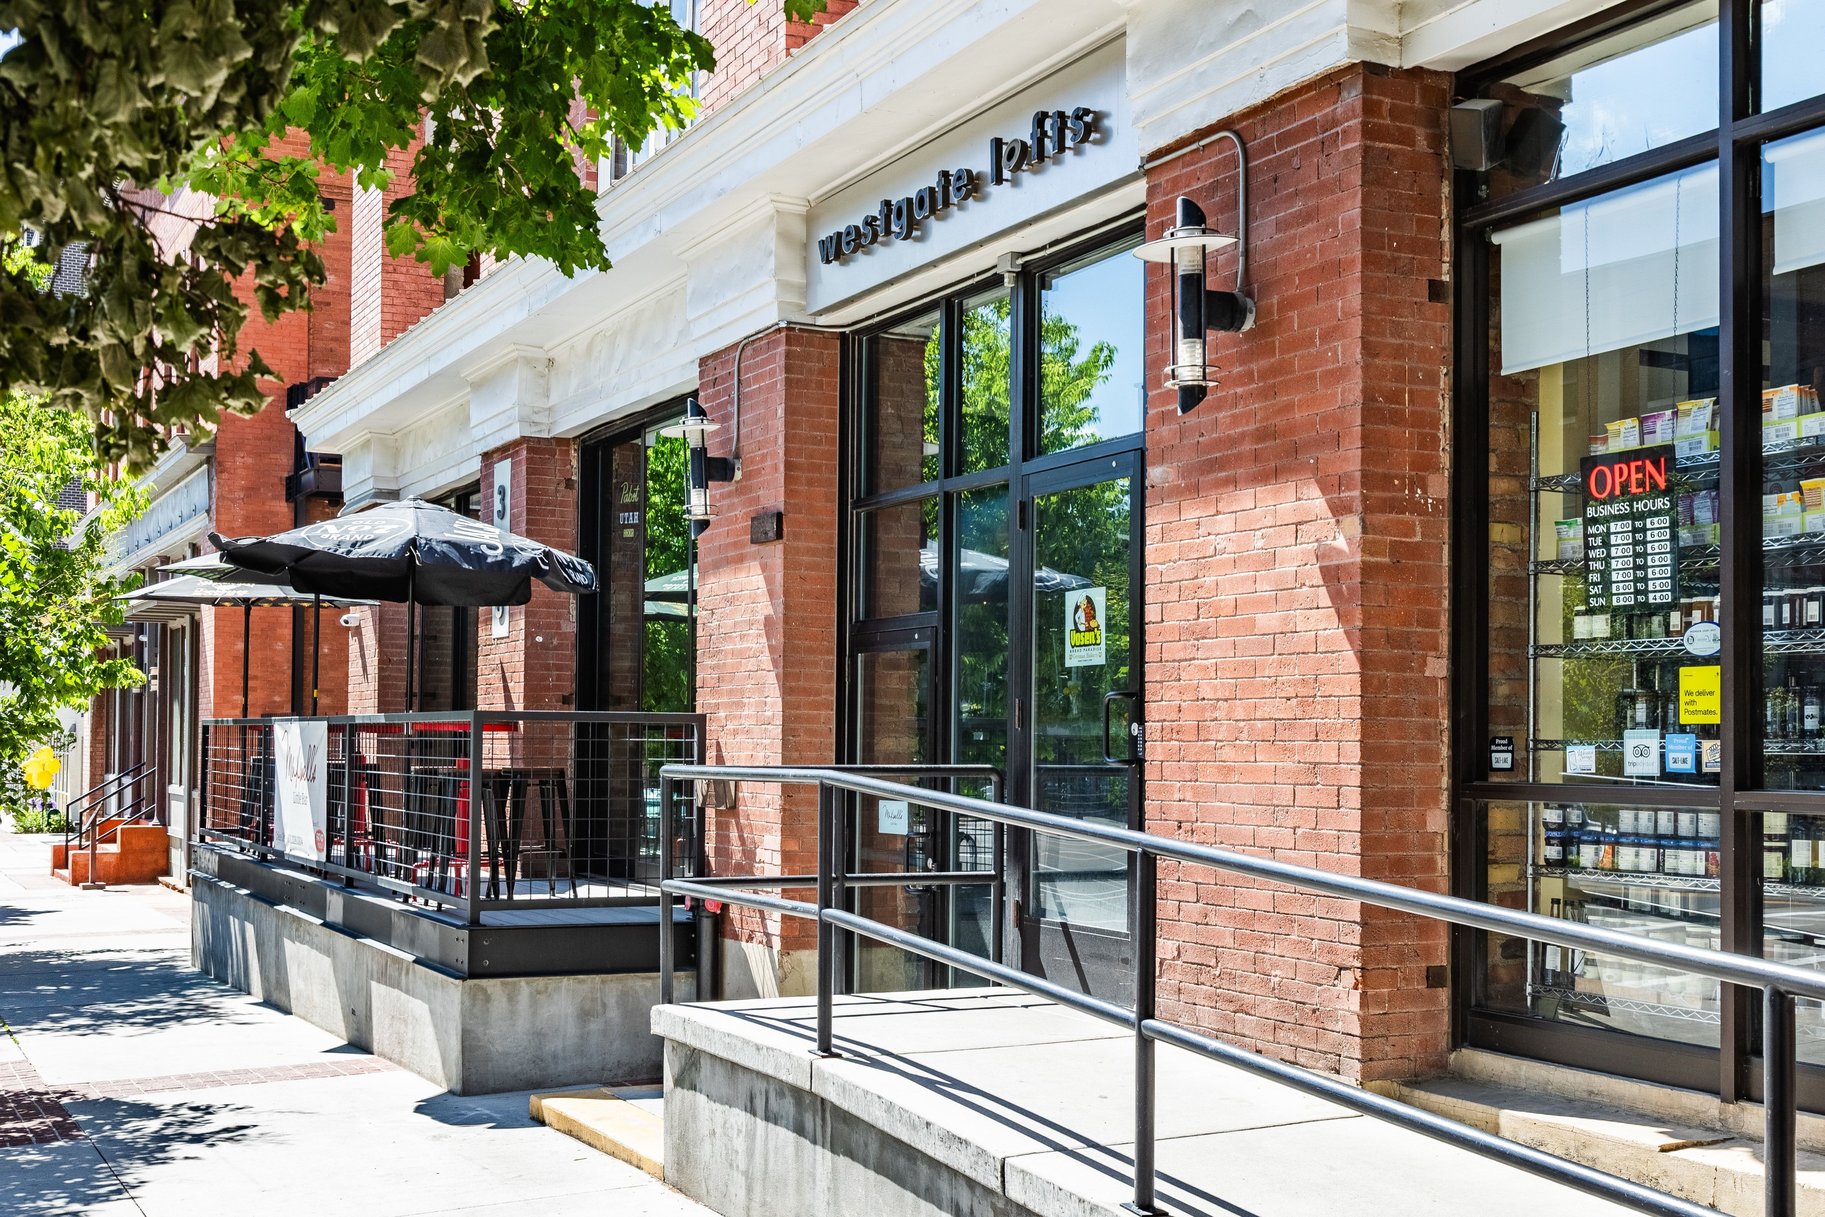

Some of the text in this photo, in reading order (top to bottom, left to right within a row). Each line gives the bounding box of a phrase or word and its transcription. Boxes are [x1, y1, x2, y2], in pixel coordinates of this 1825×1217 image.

[818, 106, 1092, 264] westgate lofts
[1589, 457, 1667, 499] OPEN
[620, 482, 640, 503] Pabst
[1587, 497, 1670, 517] BUSINESS HOURS
[619, 512, 639, 524] UTAH
[1588, 524, 1607, 534] MON
[1588, 537, 1602, 547] TUE
[1588, 549, 1606, 558] WED
[1589, 561, 1605, 570] THU
[1589, 573, 1600, 582] FRI
[1589, 585, 1602, 594] SAT
[1590, 597, 1606, 606] SUN
[1070, 628, 1102, 648] Vosen's
[1695, 689, 1715, 697] deliver
[1684, 708, 1718, 716] Postmates.
